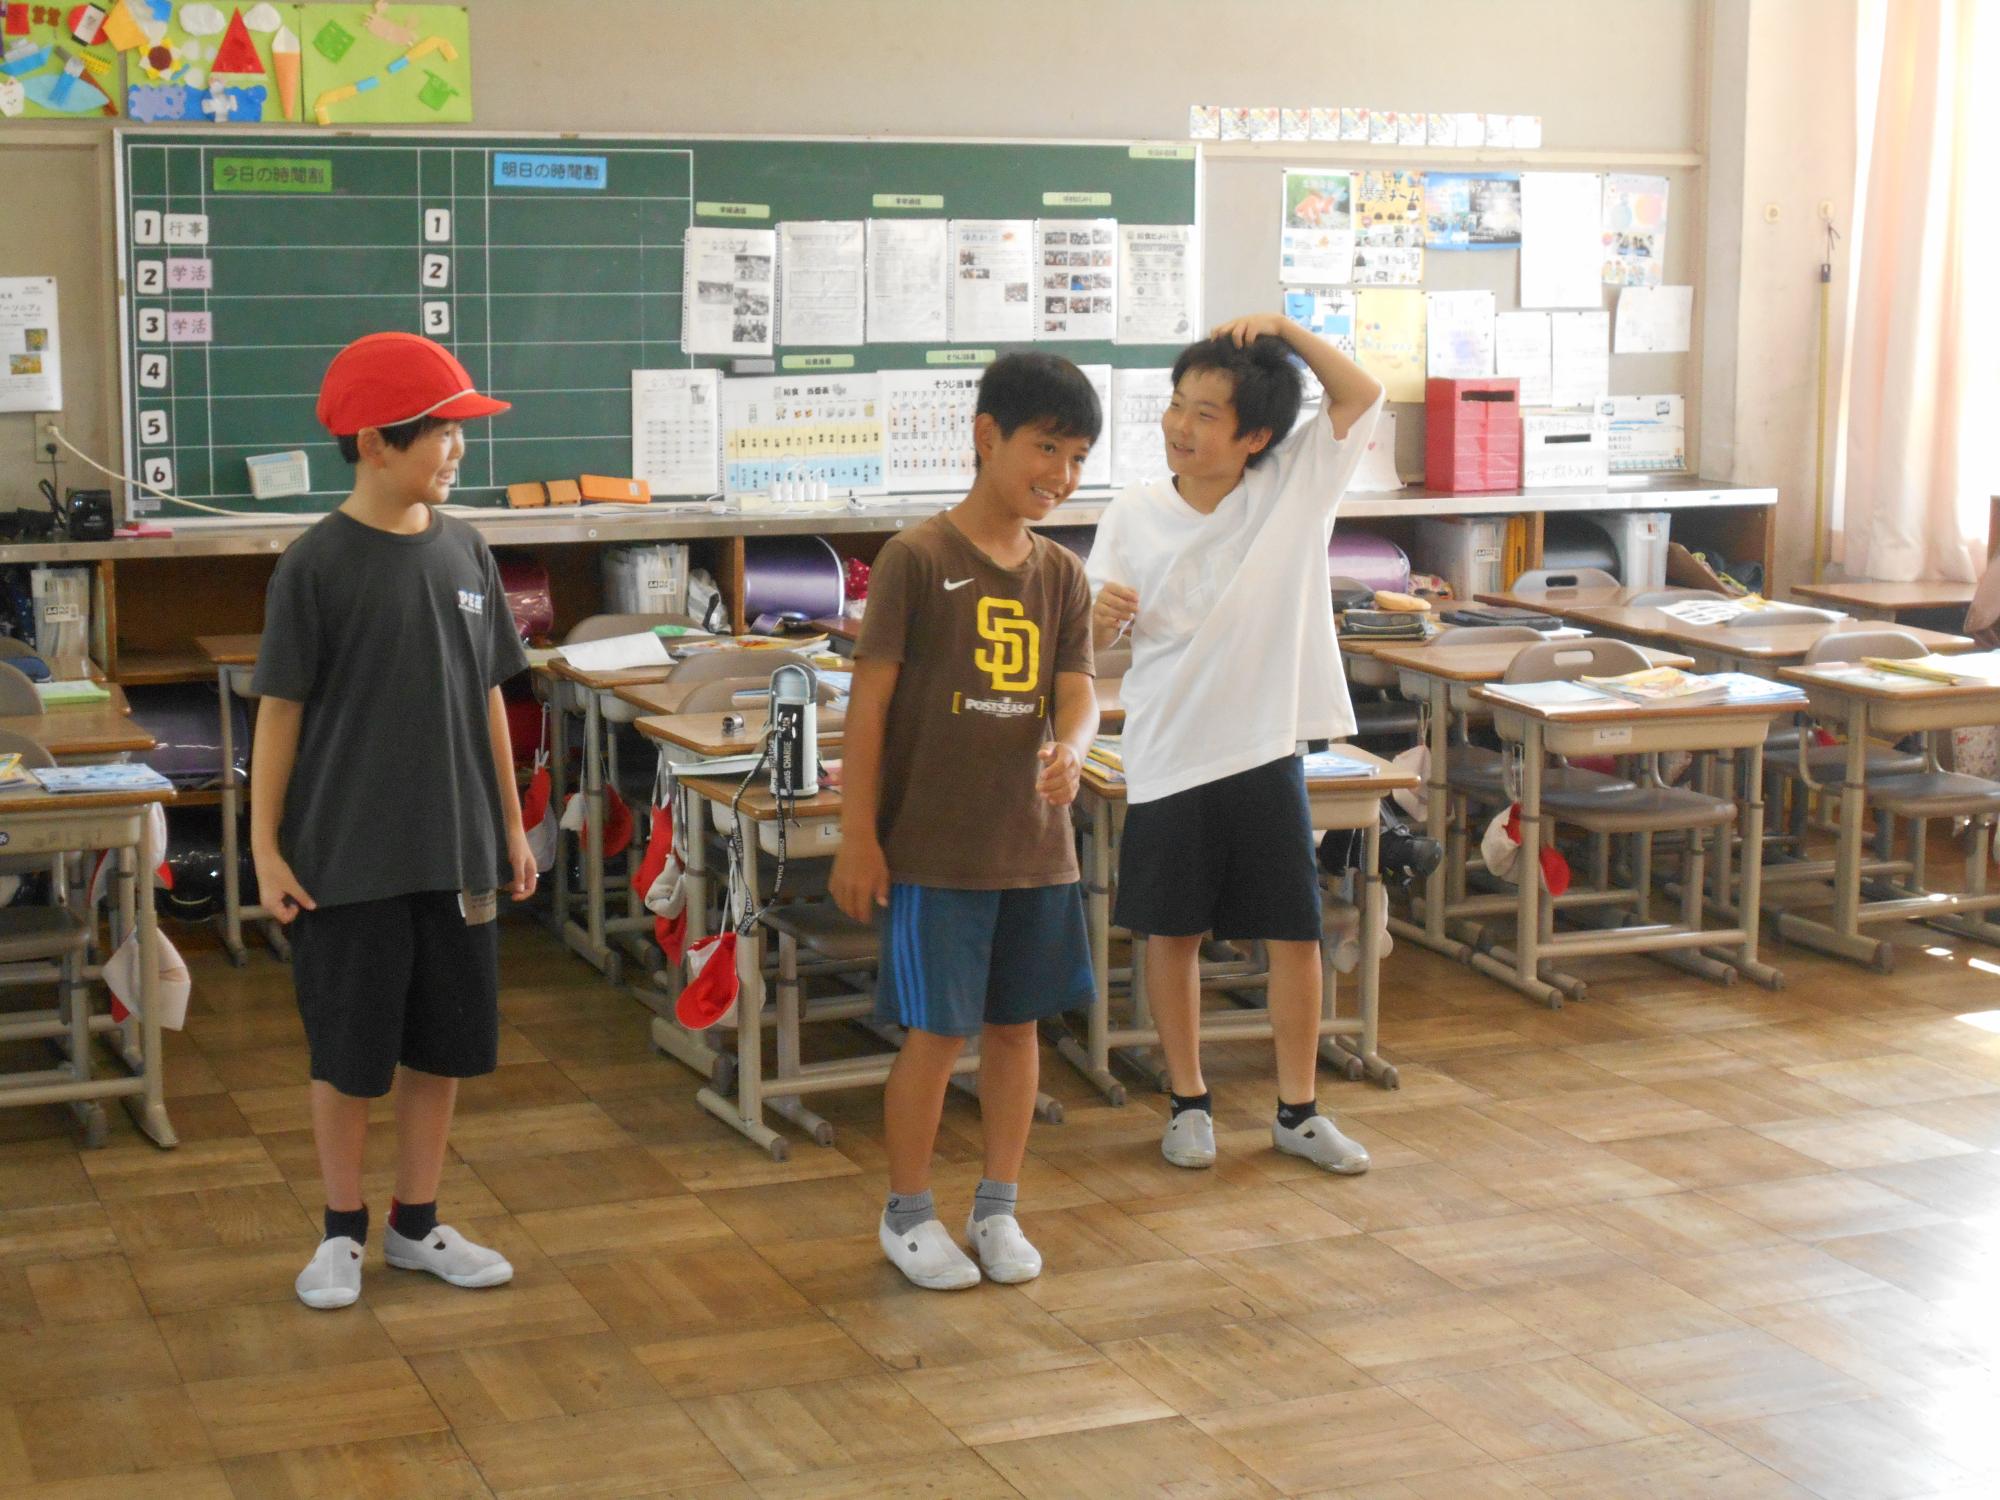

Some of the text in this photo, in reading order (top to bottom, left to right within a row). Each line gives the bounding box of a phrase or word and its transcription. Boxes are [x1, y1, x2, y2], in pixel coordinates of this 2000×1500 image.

[222, 165, 324, 185] 今日の時間割
[501, 162, 600, 181] 明日の時間割
[144, 218, 152, 236] 1
[169, 220, 203, 237] 行事
[434, 216, 441, 234] 1
[144, 269, 157, 286] 2
[172, 265, 207, 282] 学活
[429, 262, 443, 279] 2
[146, 316, 159, 333] 3
[430, 309, 443, 326] 3
[172, 318, 207, 335] 学活
[147, 362, 160, 380] 4
[148, 418, 161, 436] 5
[153, 466, 166, 483] 6
[974, 596, 1040, 692] SD
